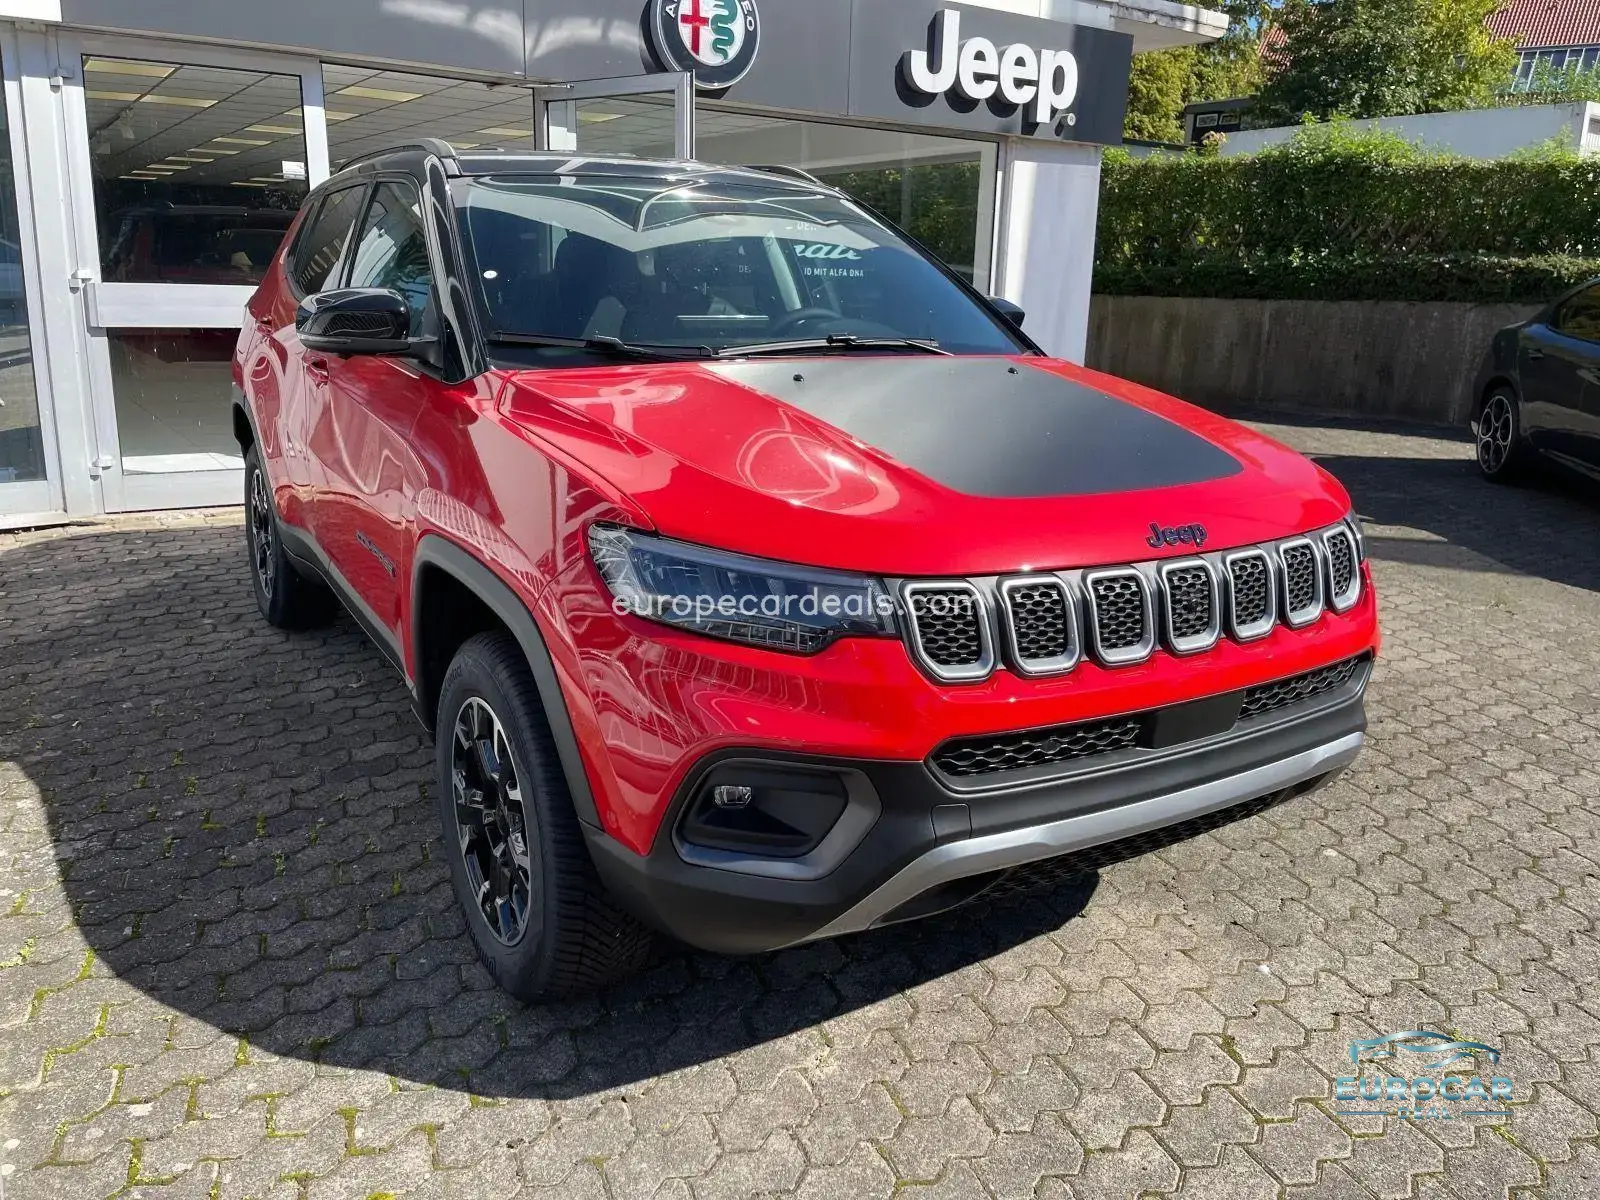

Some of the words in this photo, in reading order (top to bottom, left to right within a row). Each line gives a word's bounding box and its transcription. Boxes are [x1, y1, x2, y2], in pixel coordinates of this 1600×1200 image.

[911, 9, 1077, 124] Jeep
[813, 267, 828, 276] MIT
[829, 268, 848, 277] ALFA
[849, 269, 865, 278] DNA
[1146, 522, 1208, 548] Jeep
